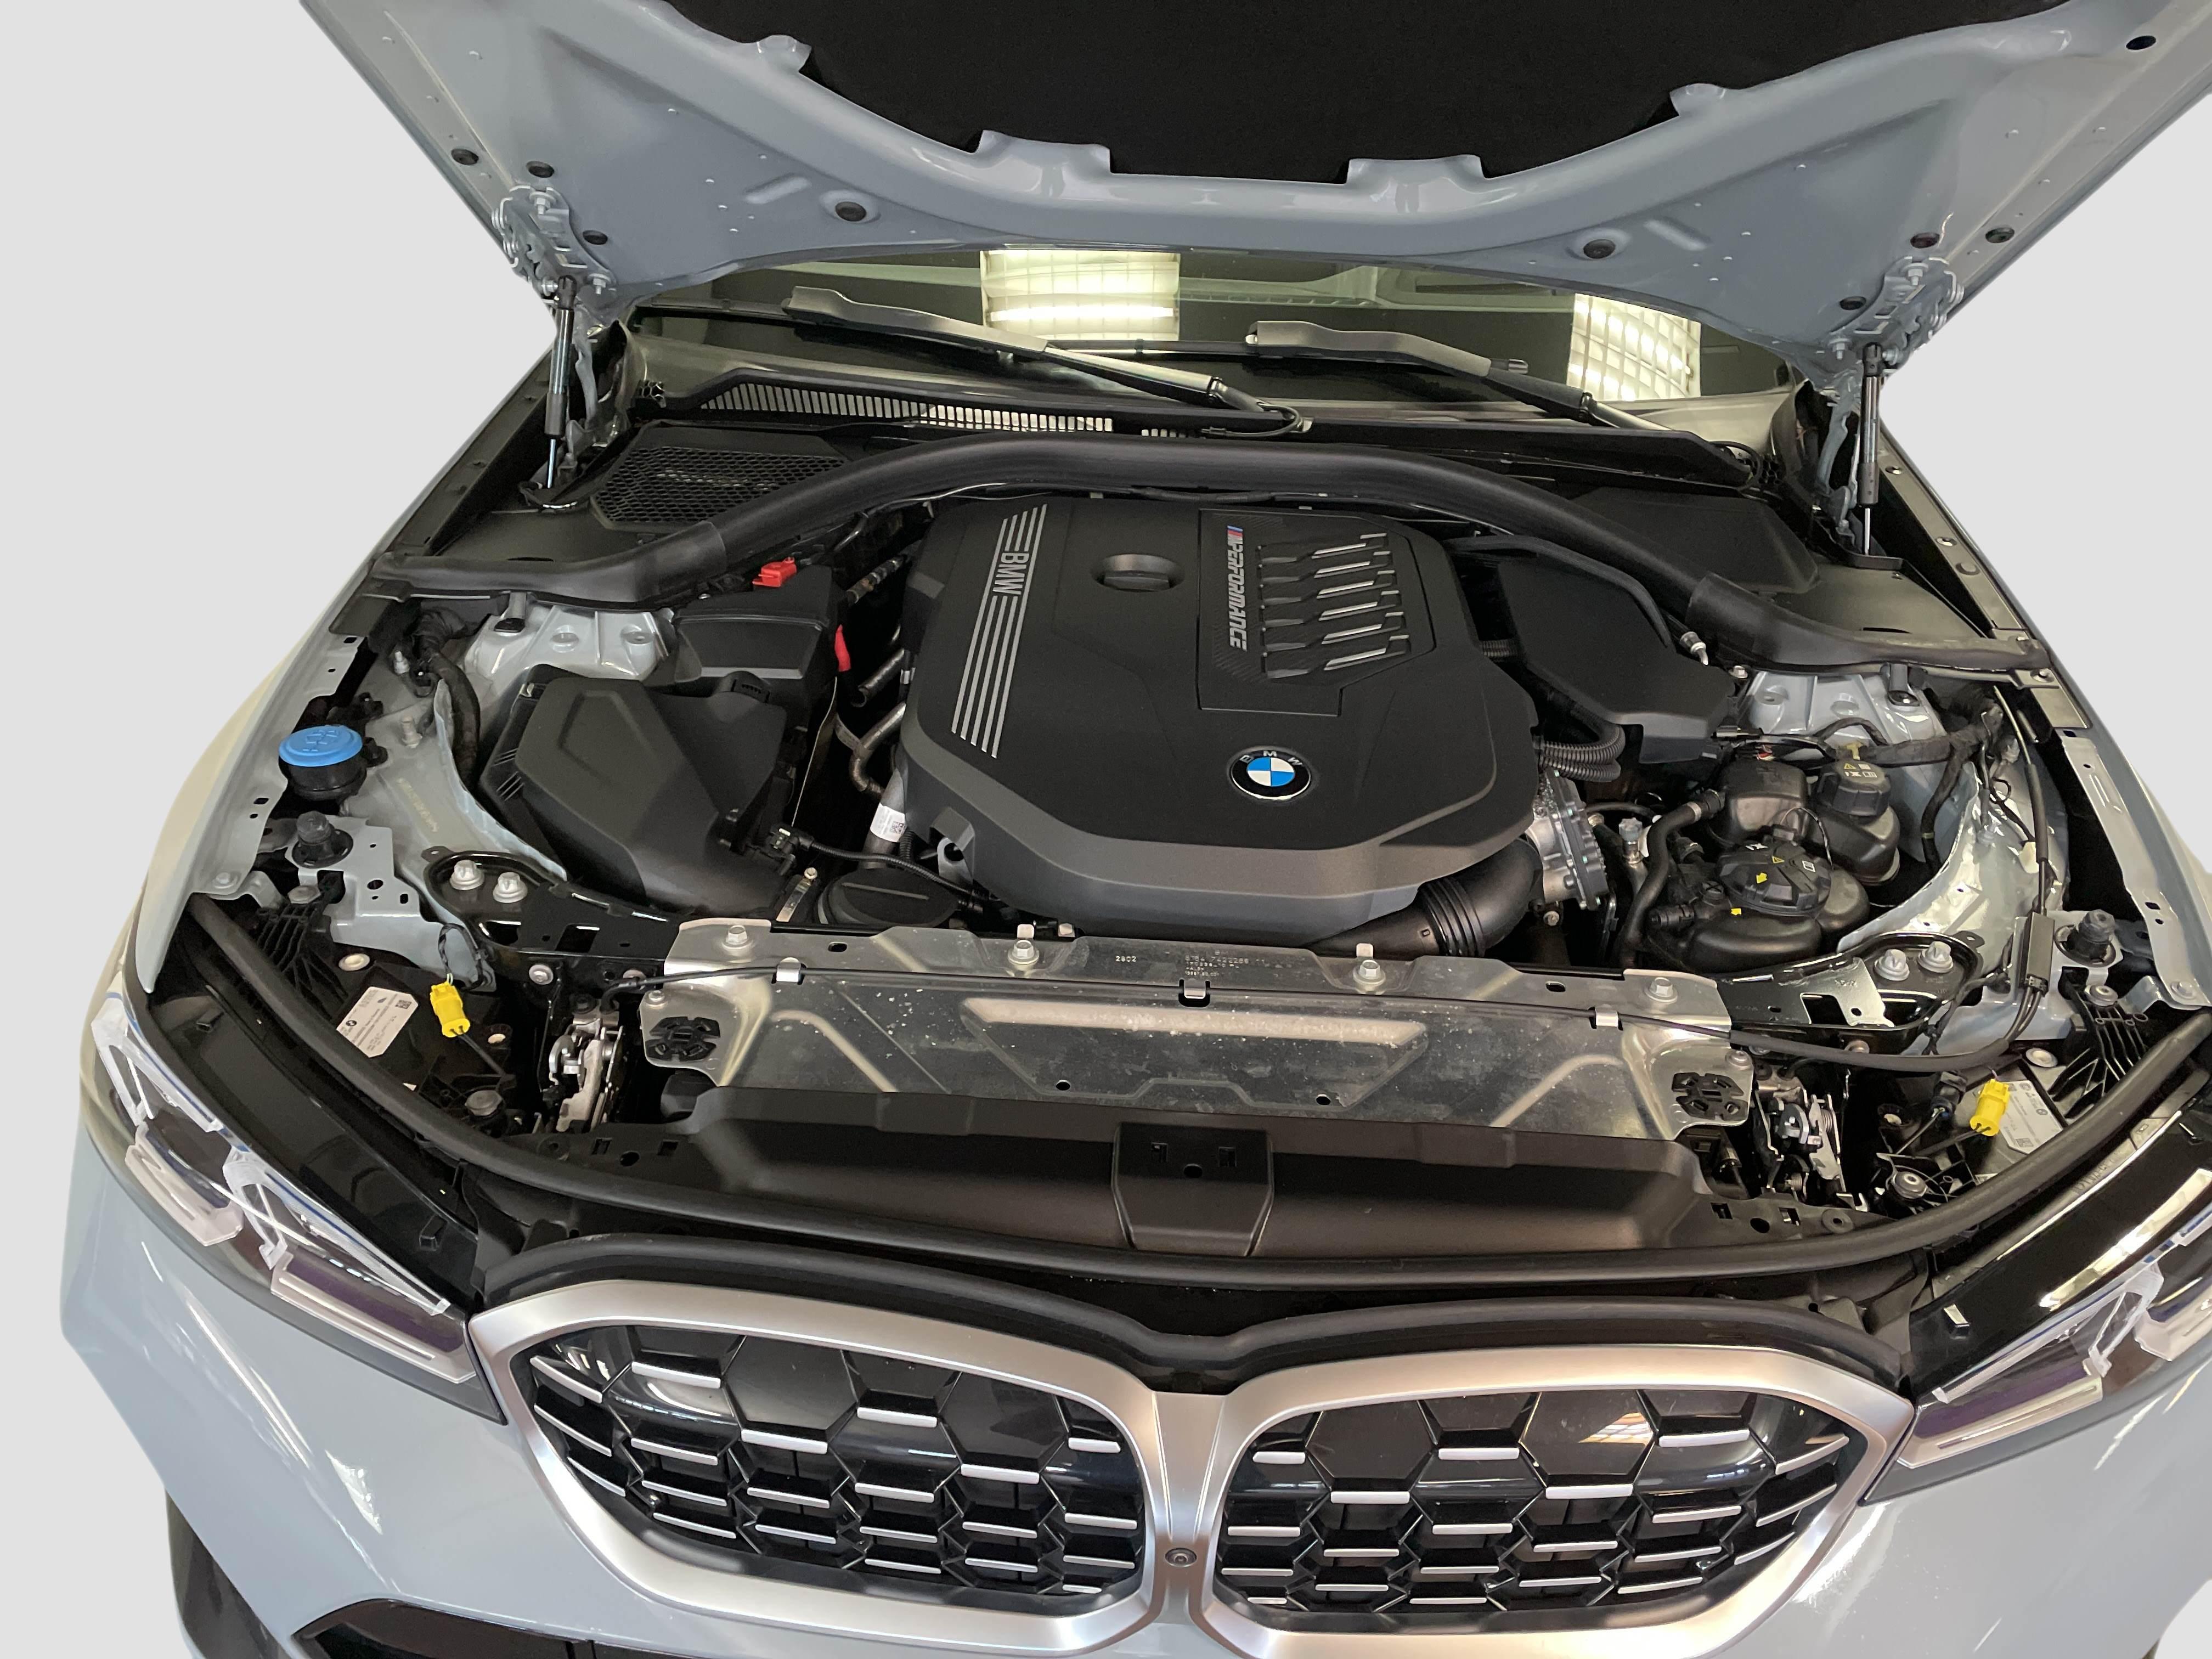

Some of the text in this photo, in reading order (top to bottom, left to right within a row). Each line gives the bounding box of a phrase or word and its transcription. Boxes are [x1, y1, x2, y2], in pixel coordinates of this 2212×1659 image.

[992, 552, 1029, 595] BMW
[1227, 543, 1248, 652] PERFORMANCE
[1240, 750, 1303, 766] BMW
